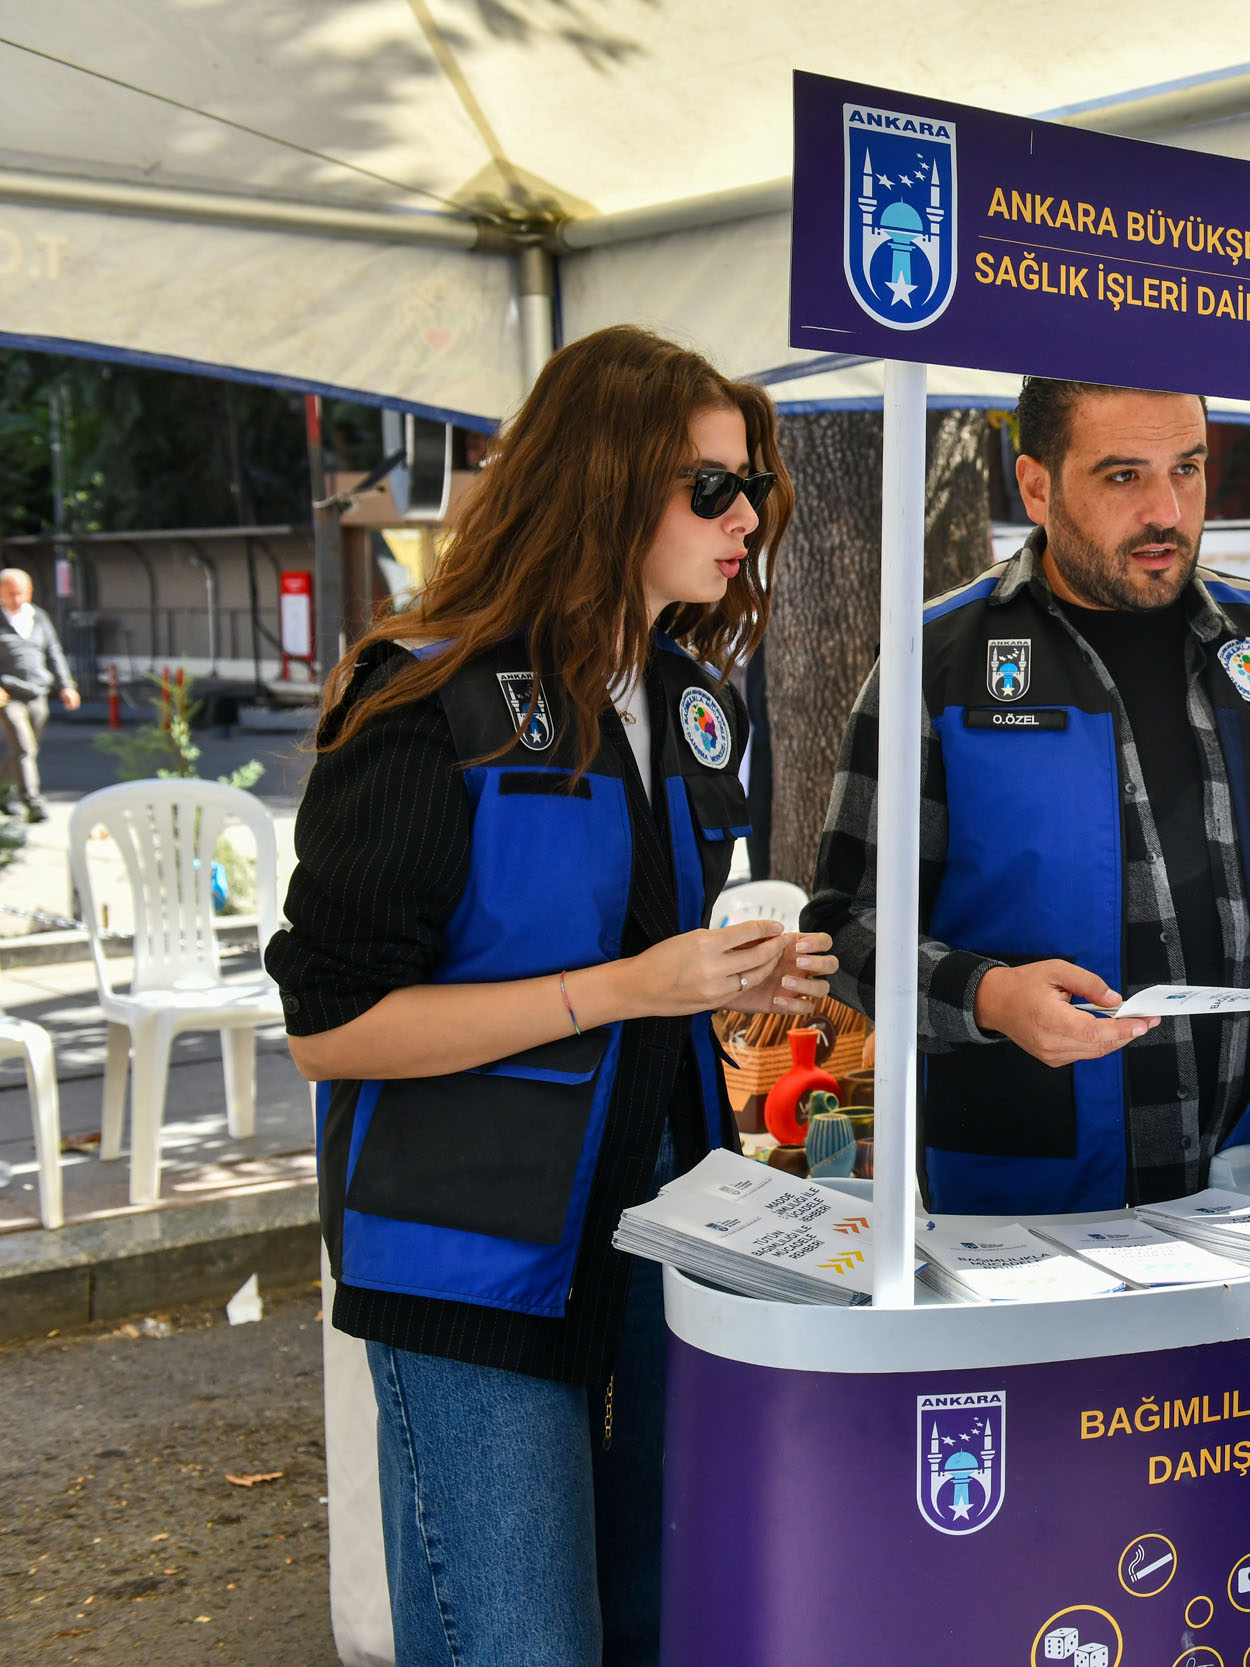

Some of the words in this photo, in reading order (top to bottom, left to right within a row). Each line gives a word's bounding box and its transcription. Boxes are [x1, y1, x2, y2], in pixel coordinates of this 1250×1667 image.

[848, 110, 951, 139] ANKARA
[987, 187, 1119, 239] ANKARA
[974, 251, 1089, 298] SAĞLIK
[1098, 263, 1187, 312] İŞLERİ
[992, 713, 1040, 725] O.ÖZEL
[764, 1192, 796, 1211] MADDE
[779, 1197, 825, 1219] ÜCADELE
[752, 1229, 785, 1246] TÜTÜN
[771, 1233, 817, 1258] MÜCADELE
[788, 1240, 825, 1259] REHBERİ
[921, 1394, 1002, 1407] ANKARA
